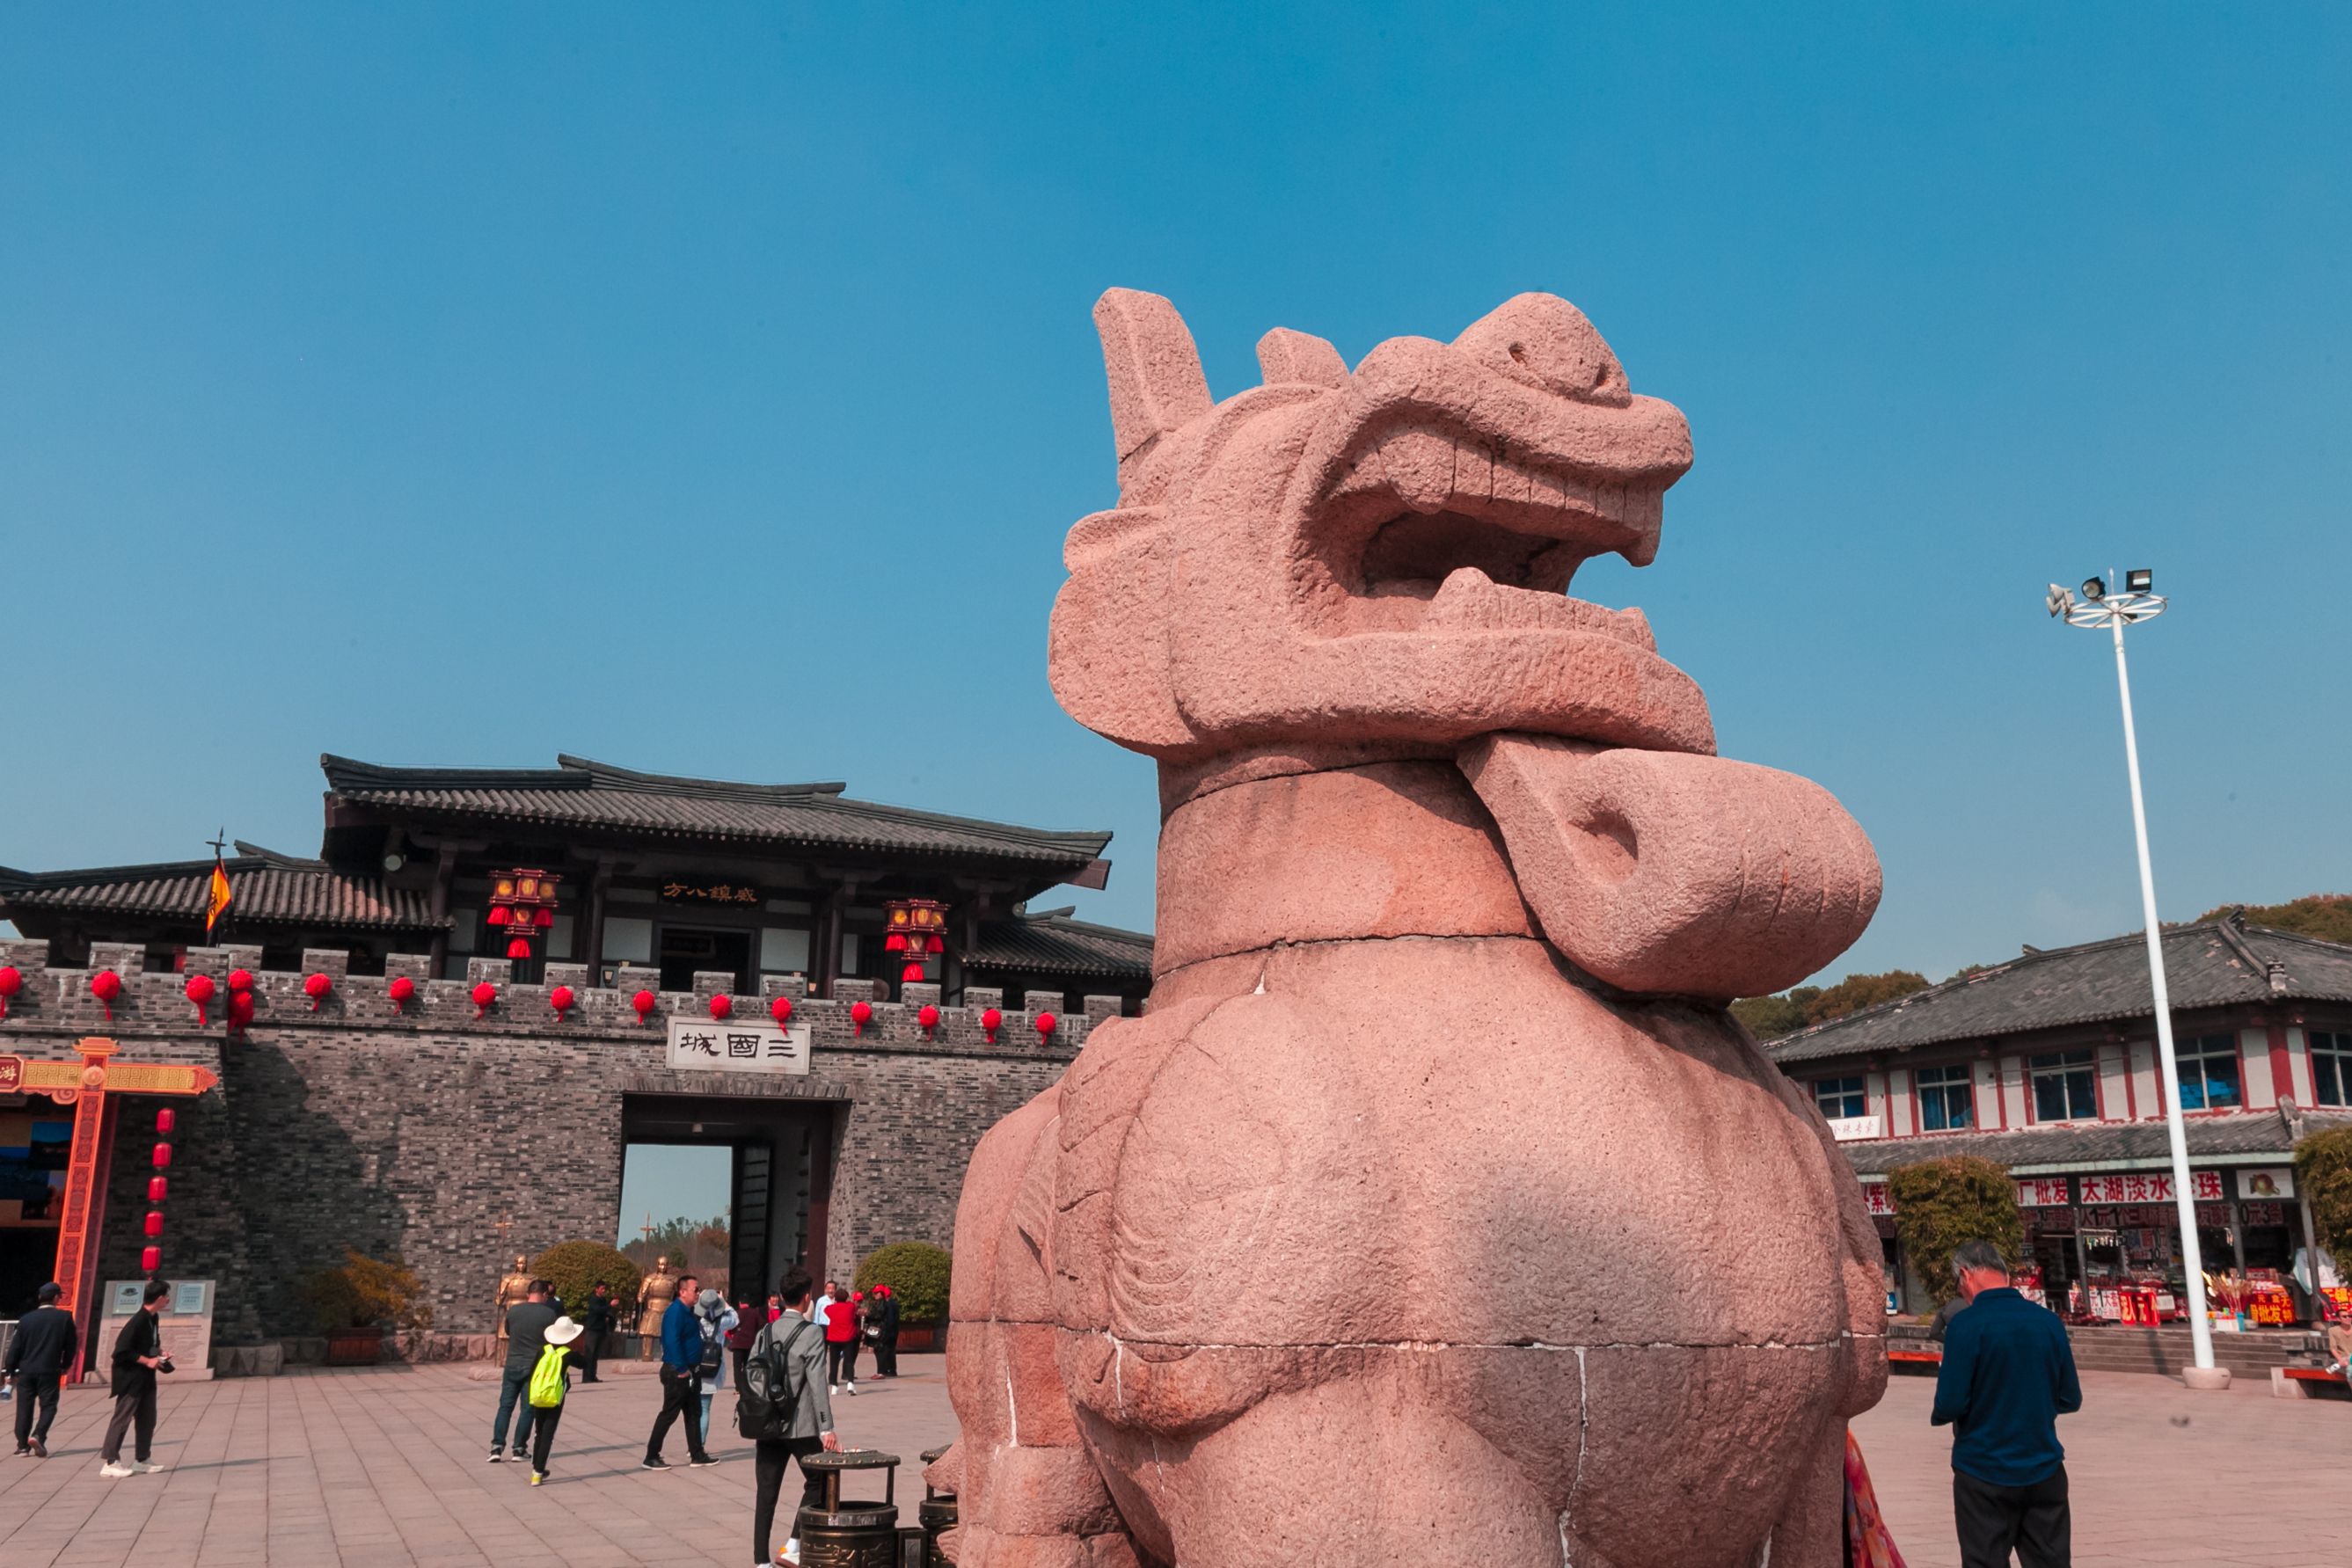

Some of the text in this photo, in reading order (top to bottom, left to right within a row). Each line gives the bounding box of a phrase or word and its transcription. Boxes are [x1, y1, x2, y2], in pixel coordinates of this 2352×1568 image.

[0, 1065, 17, 1081] 游
[2081, 1171, 2222, 1204] 太湖淡水珠
